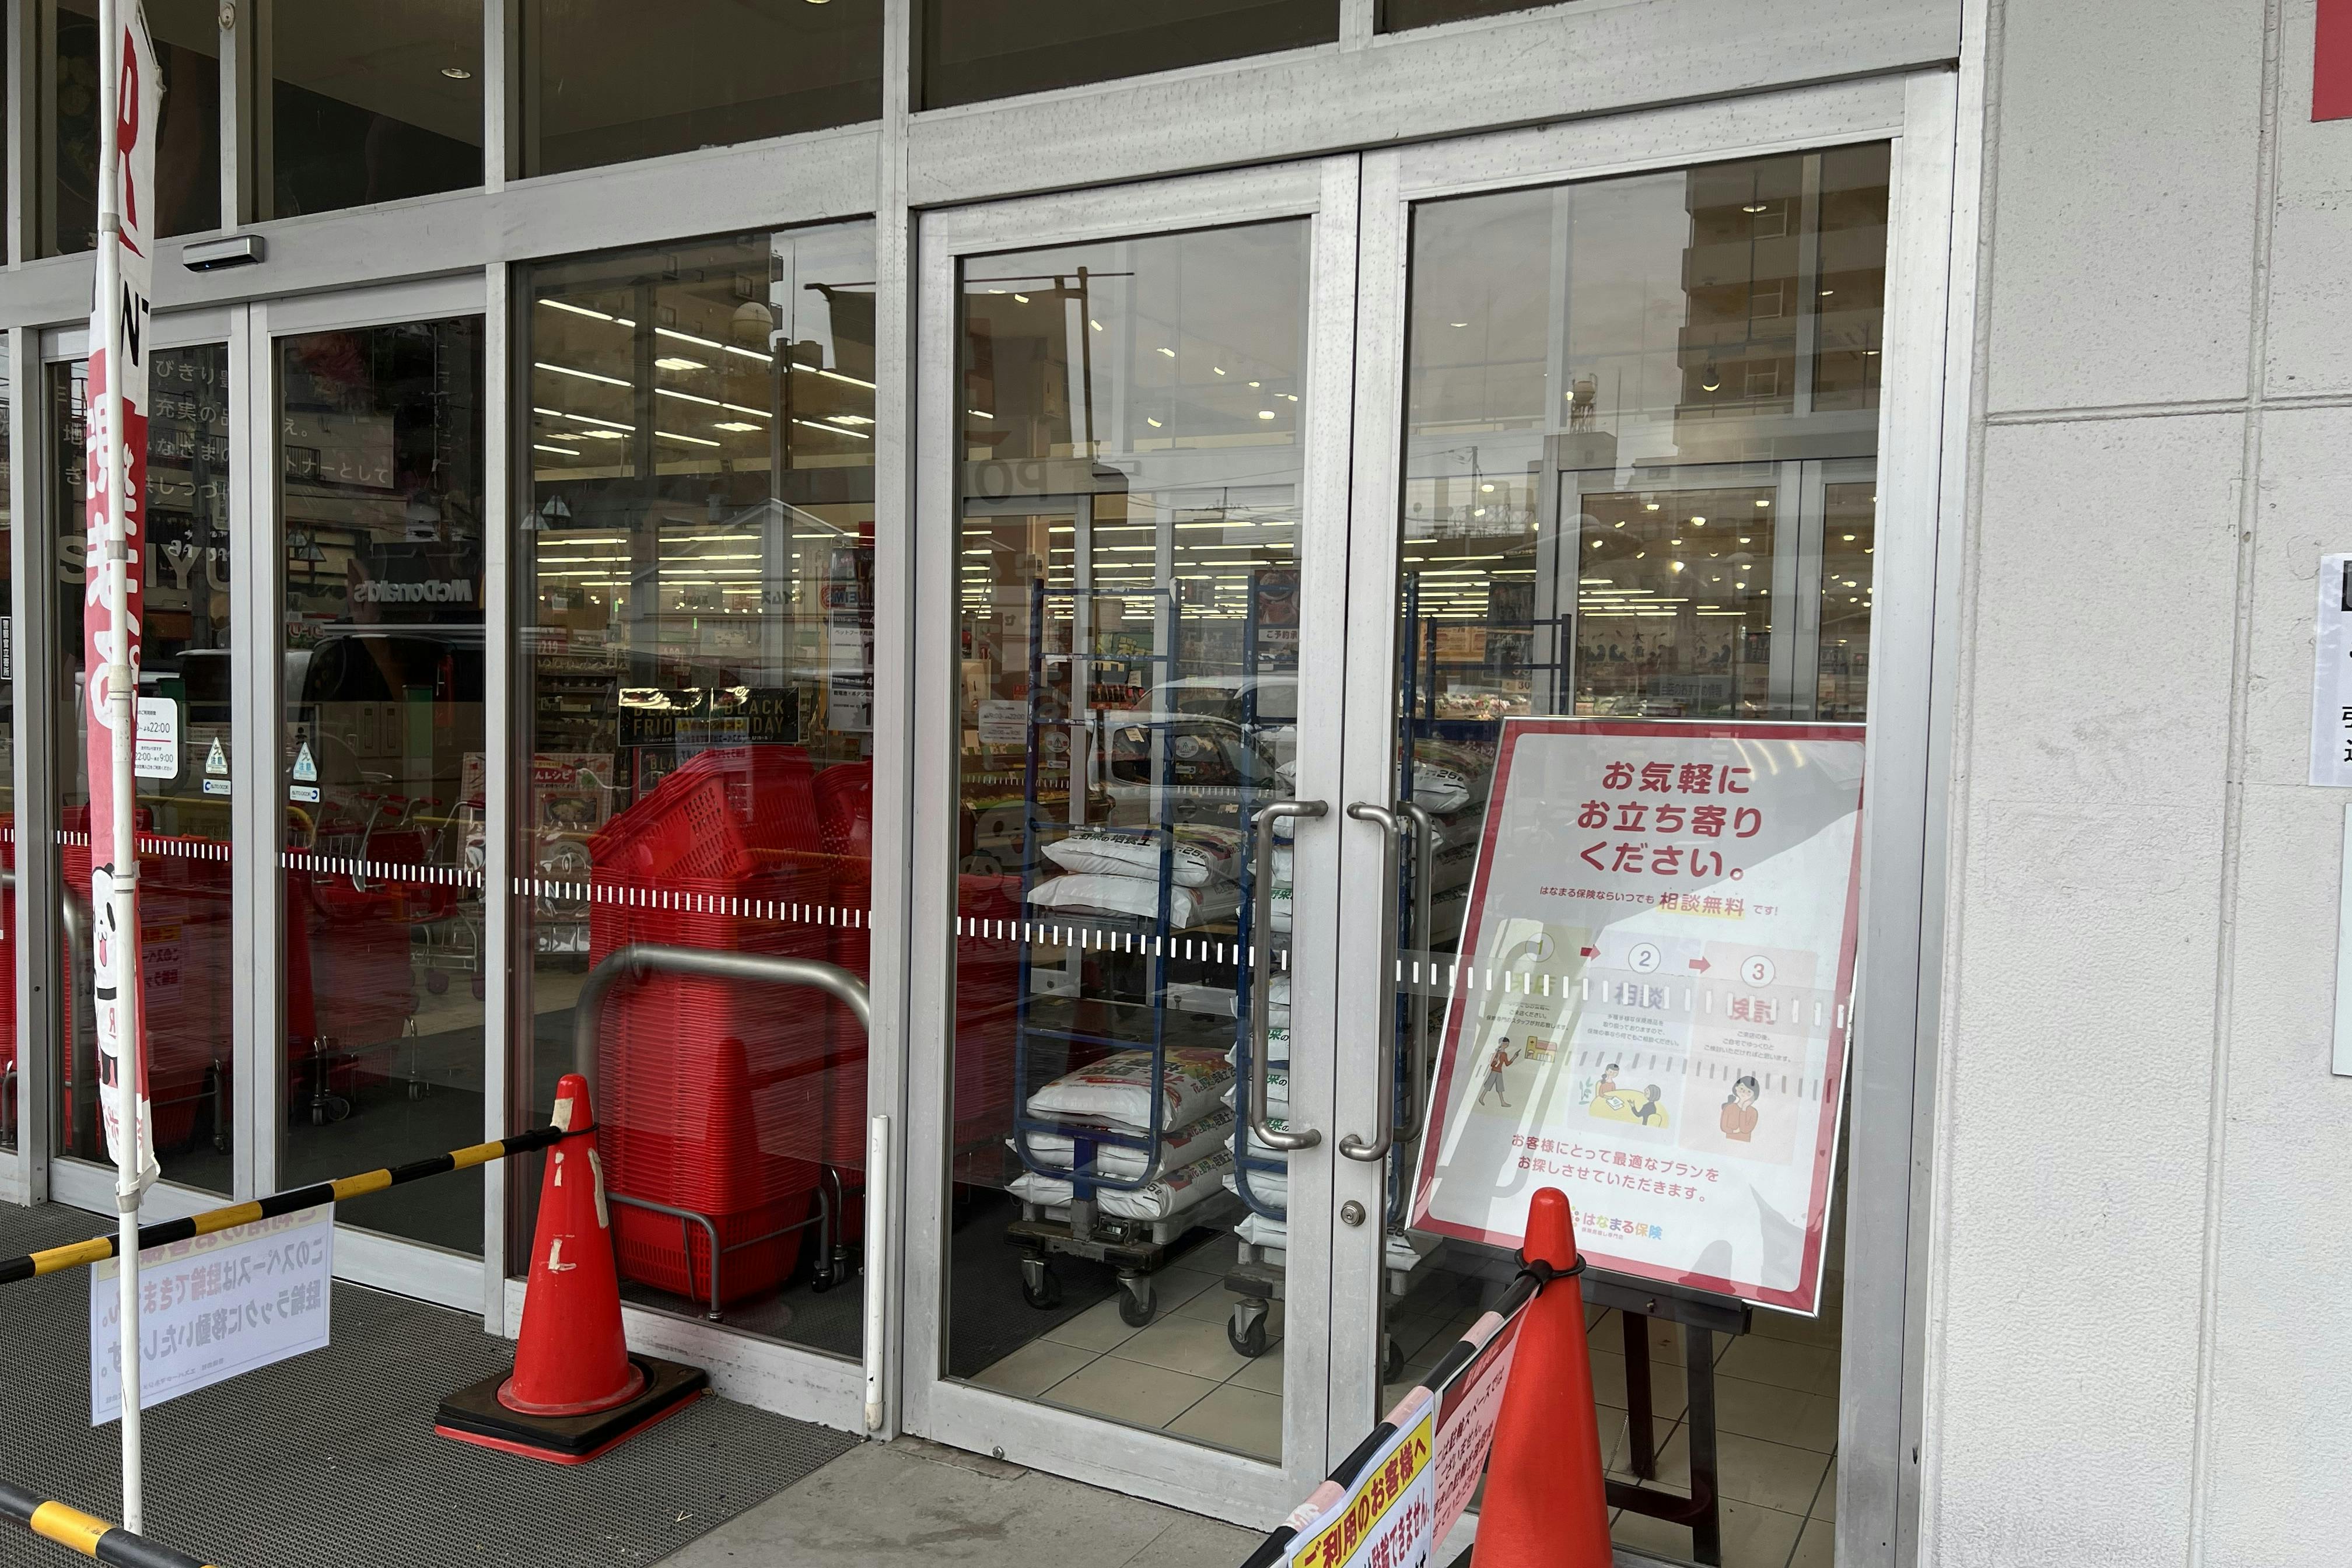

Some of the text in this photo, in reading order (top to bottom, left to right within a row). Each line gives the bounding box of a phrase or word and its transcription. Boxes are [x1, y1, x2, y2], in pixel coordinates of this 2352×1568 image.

[1602, 761, 1751, 794] お気軽に
[1577, 800, 1762, 838] お立ち寄り
[1580, 841, 1744, 881] ください。
[1540, 886, 1654, 904] はなまる保険ならいつでも
[1660, 891, 1744, 916] 相談無料
[1511, 1134, 1719, 1182] お客様にとって最適なプランを
[1518, 1156, 1706, 1203] お探しさせていただきます。
[1583, 1212, 1663, 1240] はなまる保険
[1304, 1438, 1426, 1568] ご利用のお客様へ
